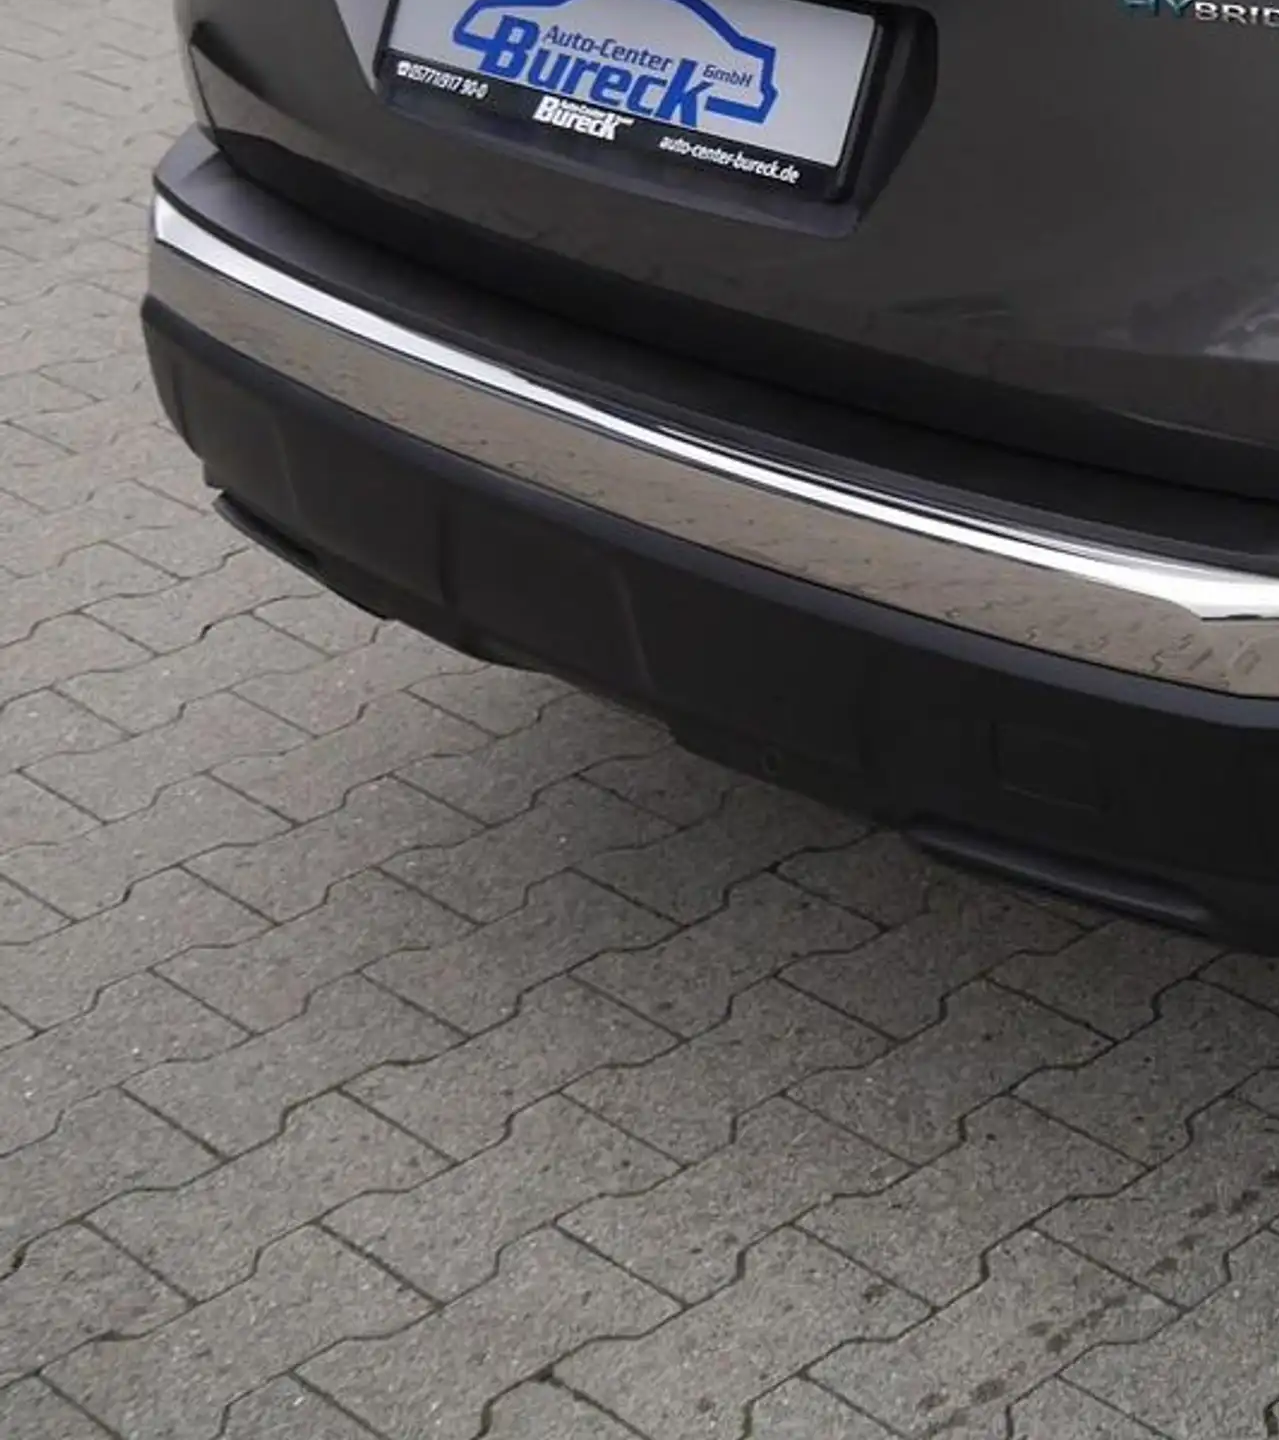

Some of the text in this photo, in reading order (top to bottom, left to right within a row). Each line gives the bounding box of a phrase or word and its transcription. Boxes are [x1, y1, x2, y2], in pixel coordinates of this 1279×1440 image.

[479, 14, 708, 128] Bureck
[543, 24, 754, 89] Auto-Center GmbH
[532, 94, 620, 141] Bureck
[658, 134, 800, 185] auto-center-bureck.de
